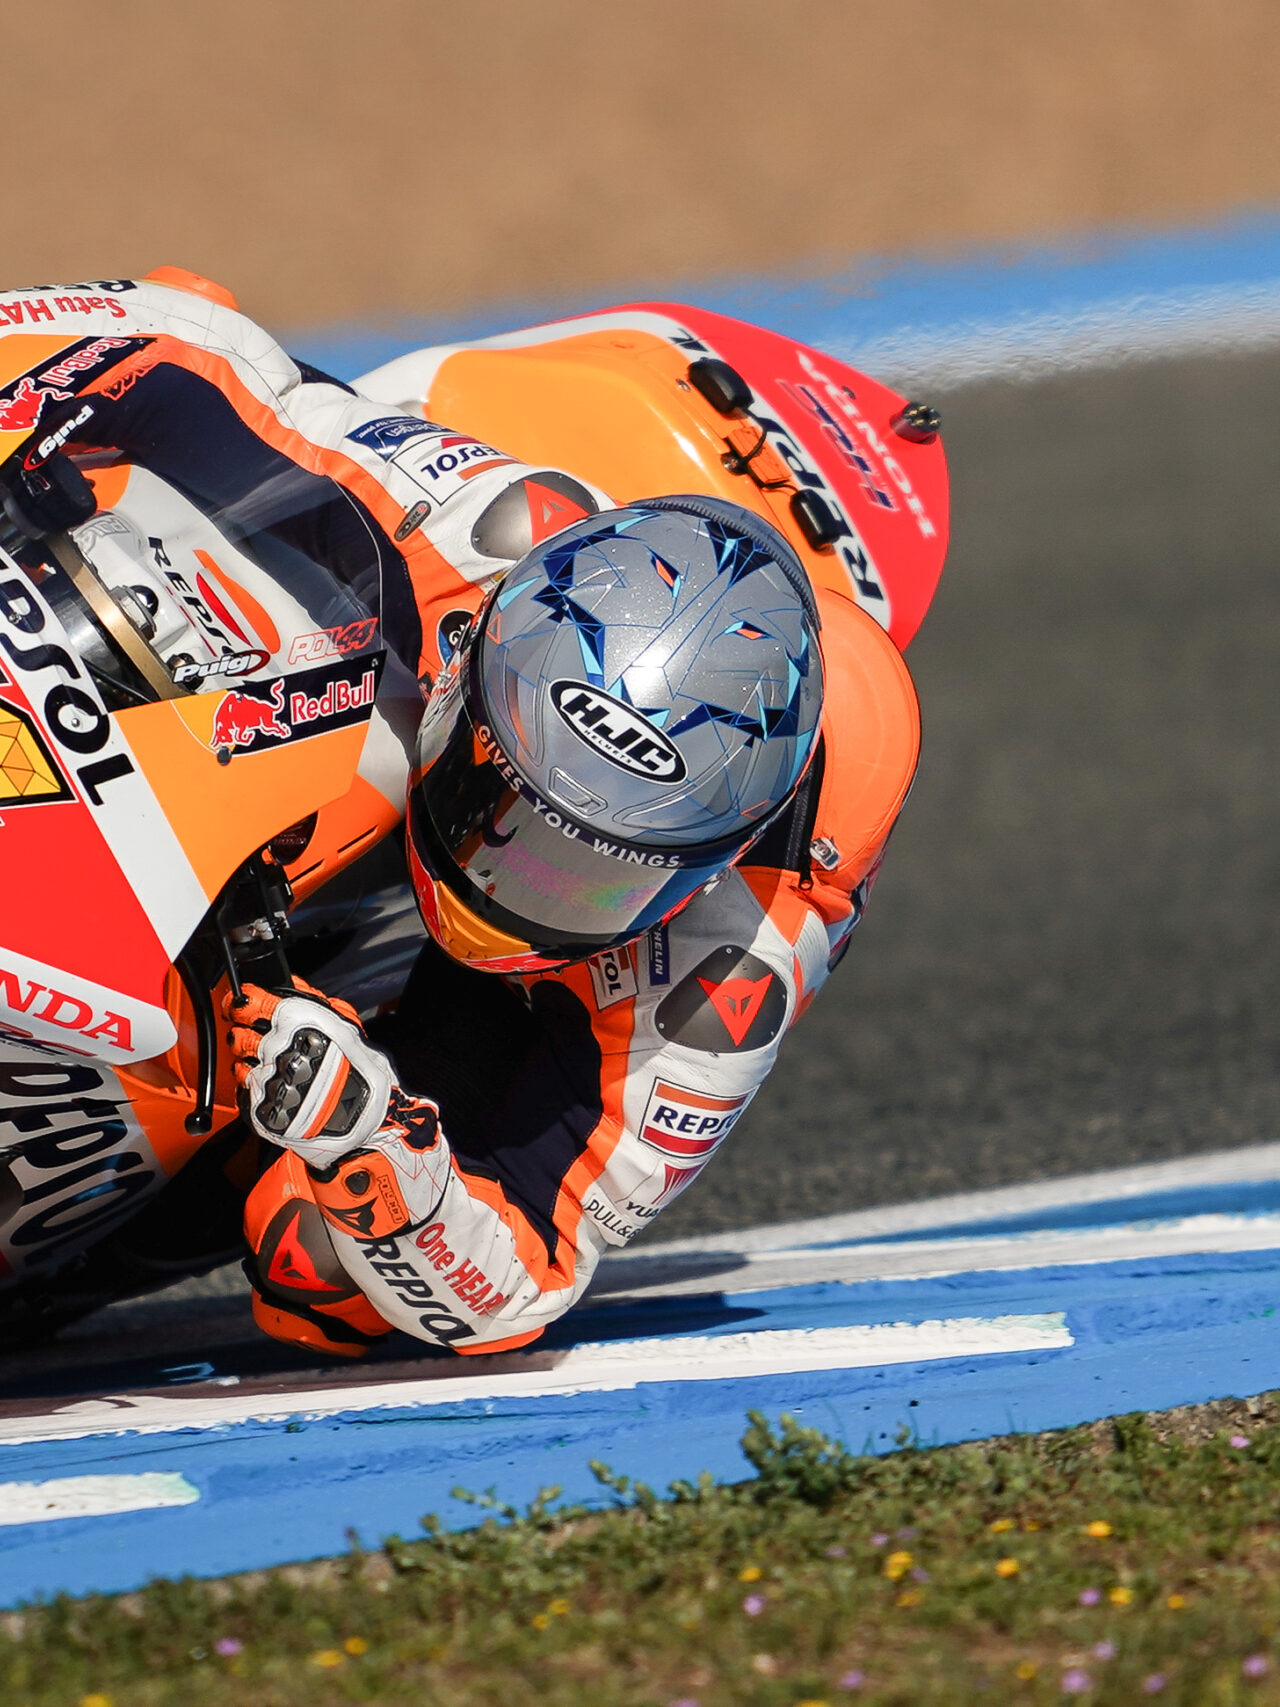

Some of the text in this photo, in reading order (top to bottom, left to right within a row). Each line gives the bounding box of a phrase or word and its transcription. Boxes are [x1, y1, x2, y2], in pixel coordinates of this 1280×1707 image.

[54, 296, 127, 318] Satu
[37, 404, 95, 459] Puig
[795, 350, 936, 538] HONDA
[420, 445, 501, 481] EPSOL
[148, 536, 234, 656] REPS
[288, 617, 379, 665] POL44
[173, 652, 251, 684] Puig
[560, 692, 676, 774] HJC
[583, 729, 633, 765] HELMETS
[477, 725, 682, 869] GIVES YOU WINGS
[652, 1105, 742, 1135] REPSO
[625, 1201, 660, 1218] YUA
[416, 1222, 505, 1316] One HEAR
